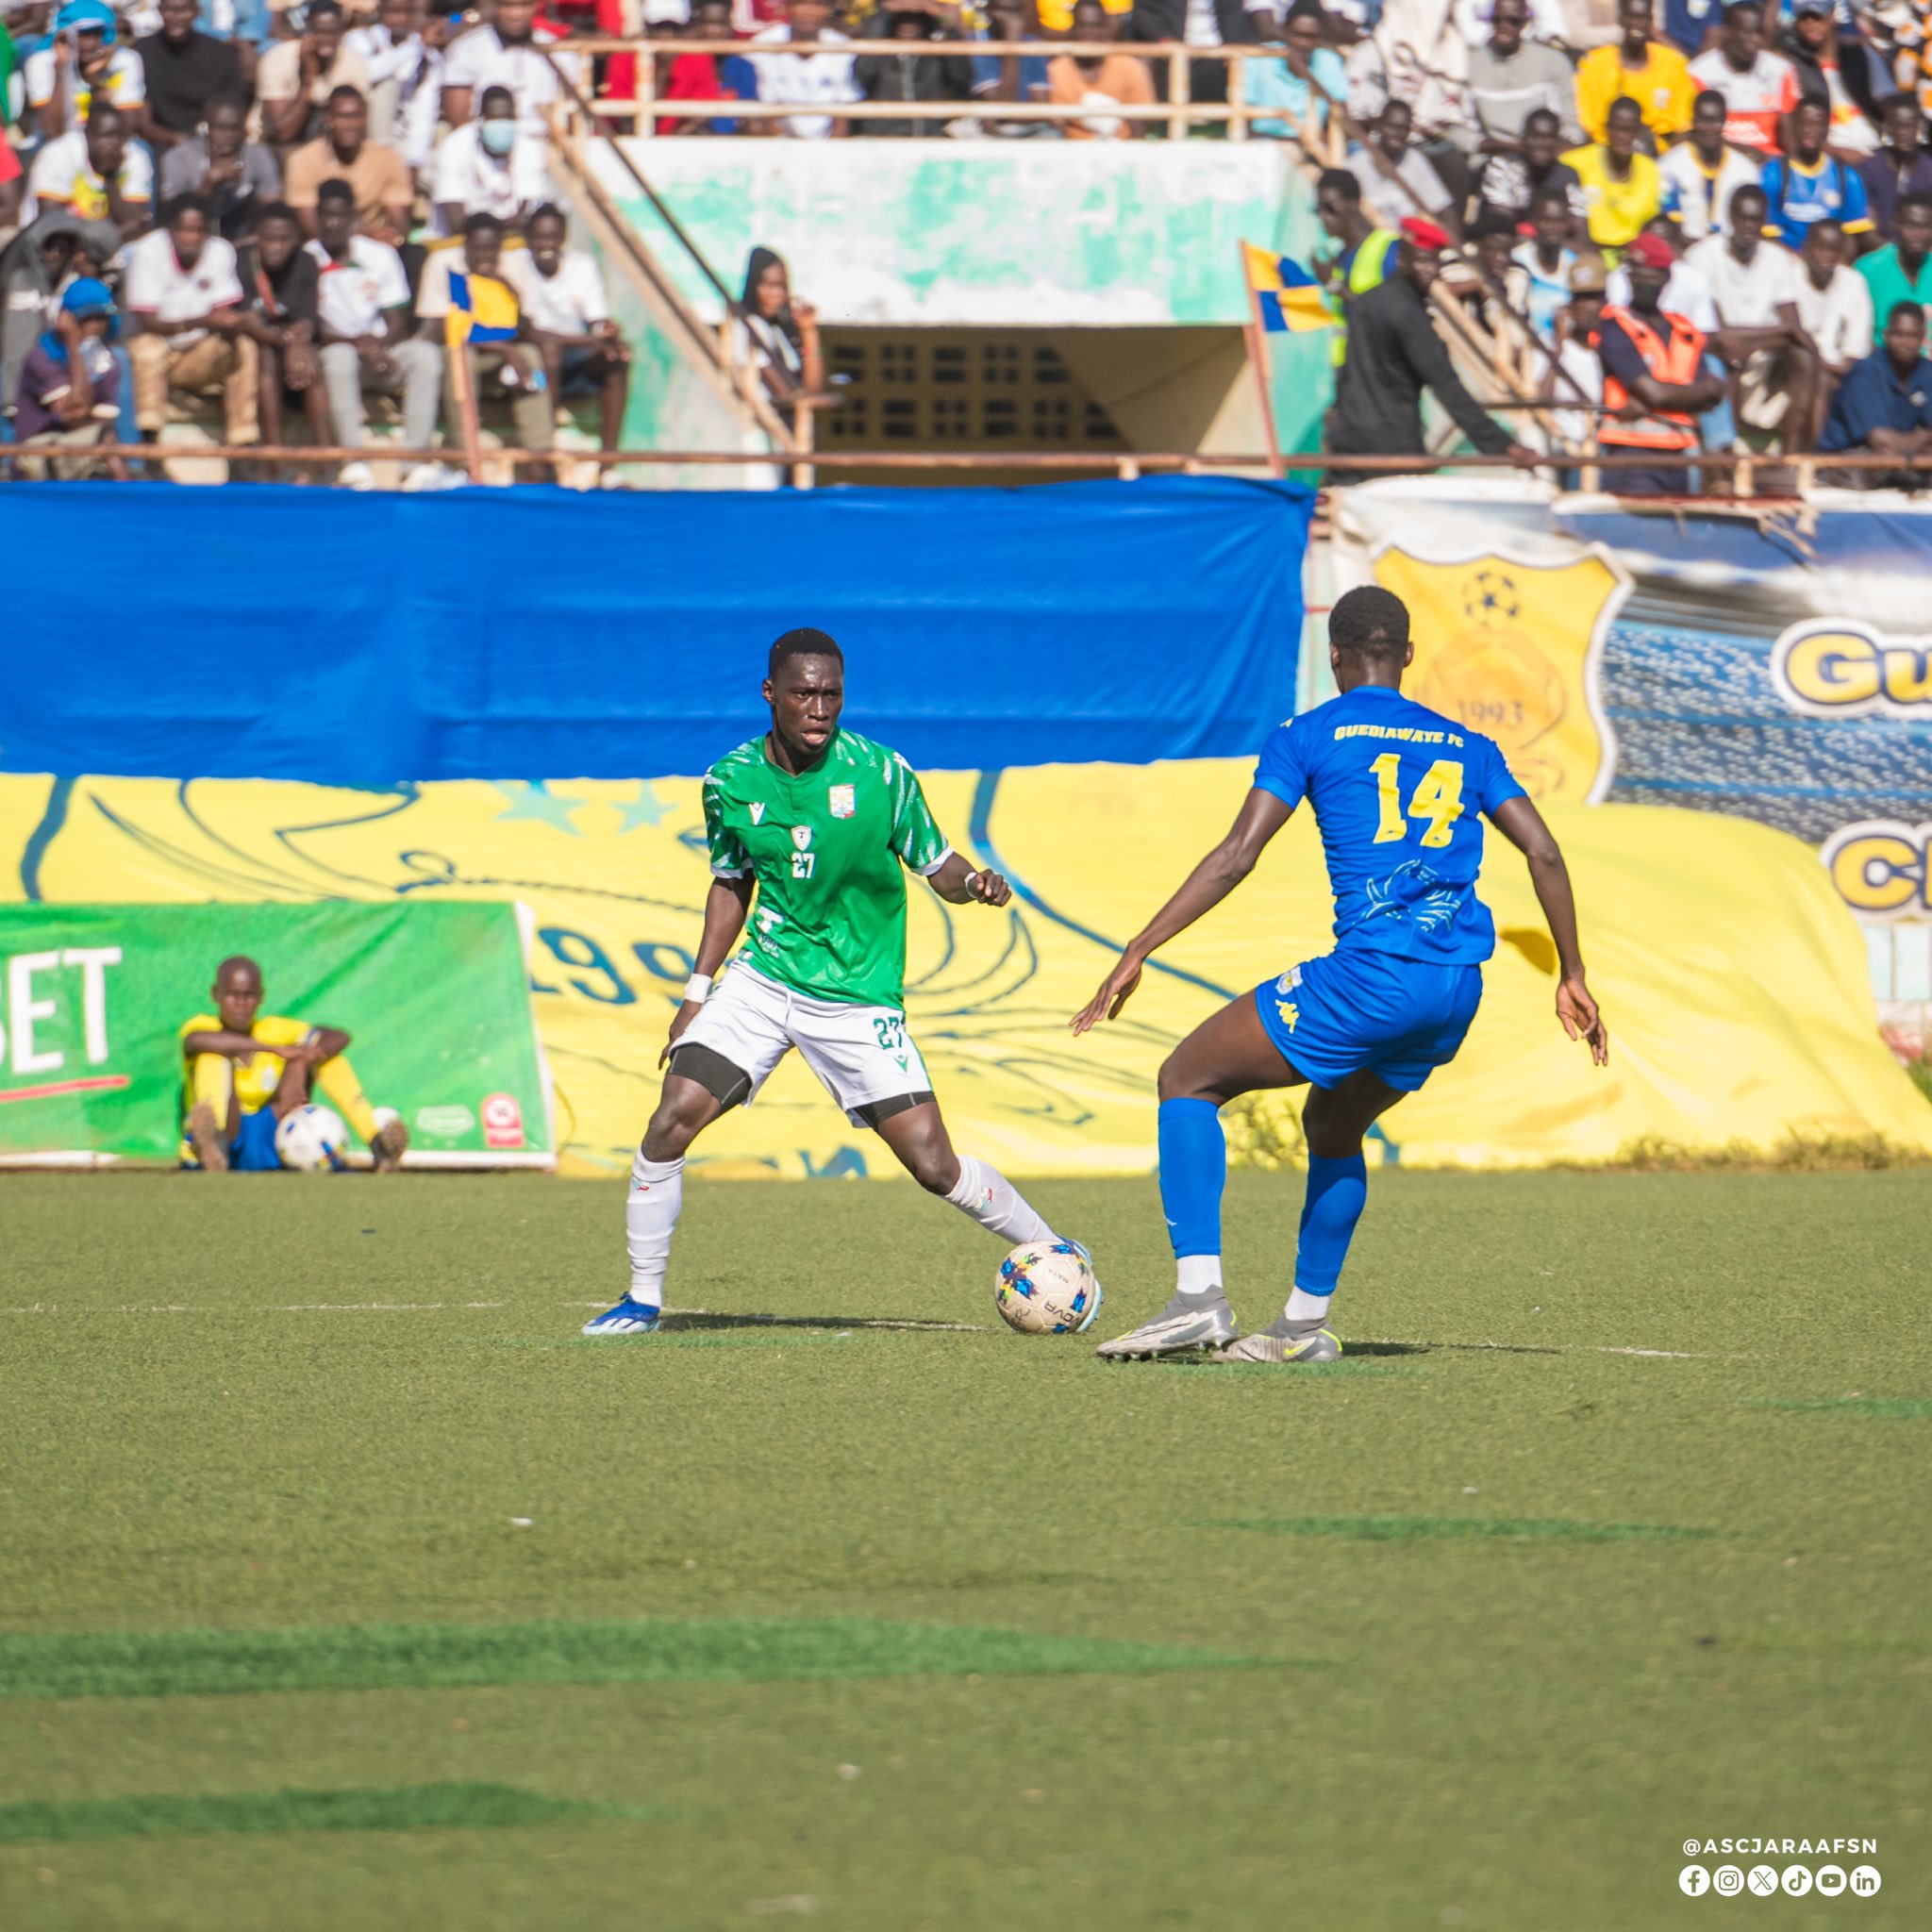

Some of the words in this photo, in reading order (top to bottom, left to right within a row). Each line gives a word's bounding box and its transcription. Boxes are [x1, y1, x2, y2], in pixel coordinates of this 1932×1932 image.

[1458, 699, 1524, 727] 1993
[1334, 724, 1444, 741] GUEDIAWAYE
[1447, 733, 1464, 748] FC
[1369, 753, 1465, 848] 14
[791, 852, 815, 878] 27
[0, 946, 122, 1073] ET
[874, 1016, 903, 1050] 27
